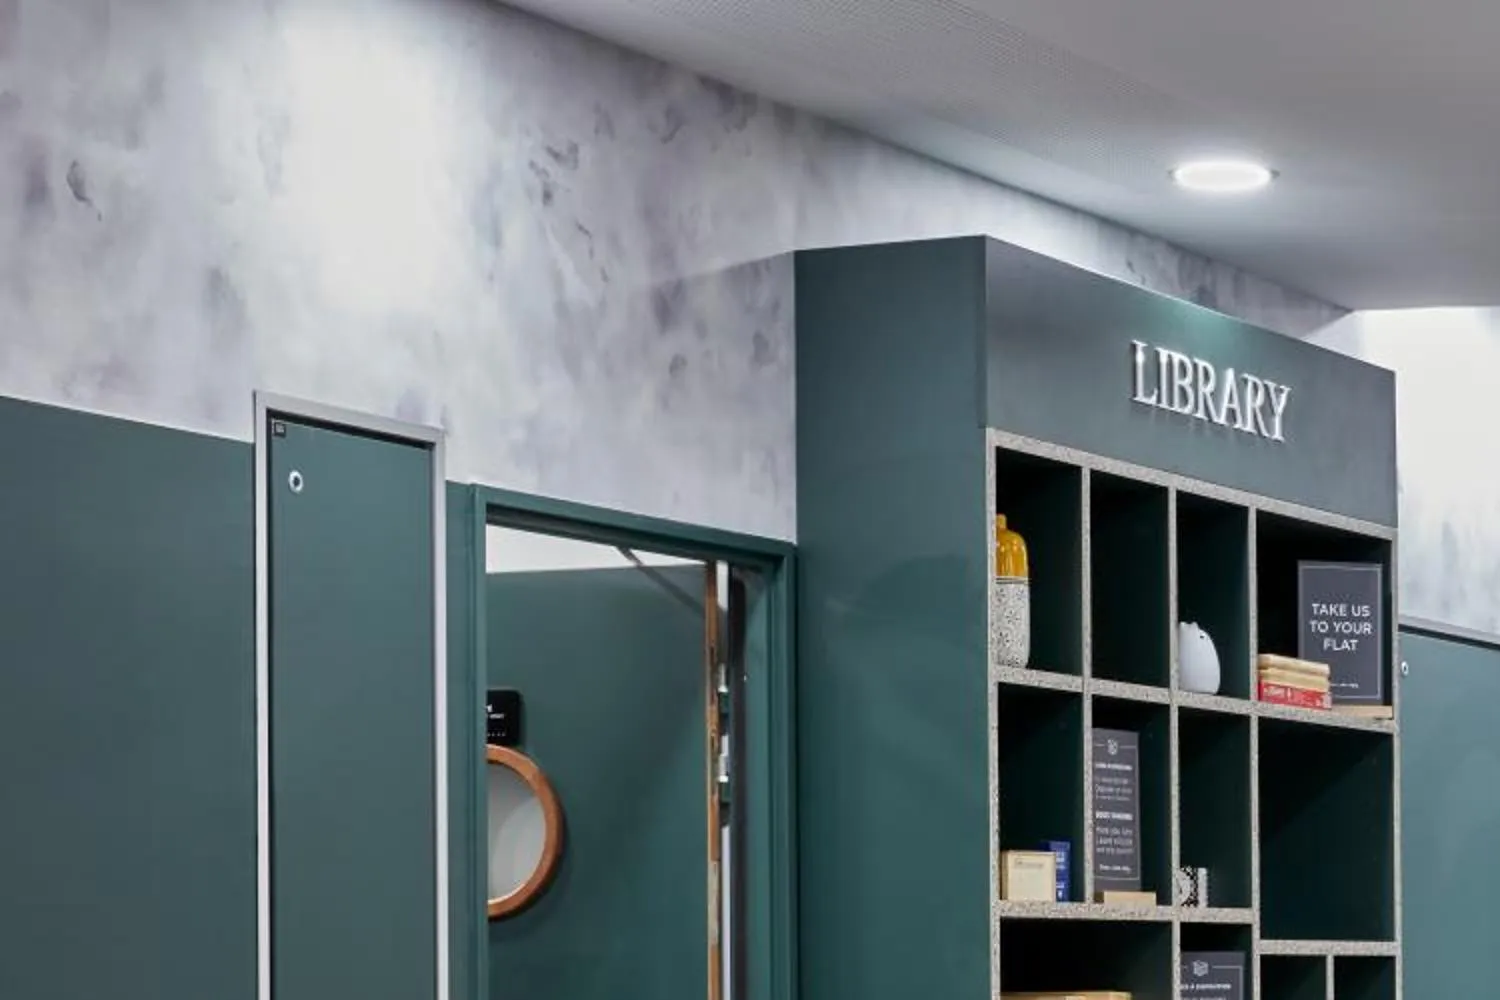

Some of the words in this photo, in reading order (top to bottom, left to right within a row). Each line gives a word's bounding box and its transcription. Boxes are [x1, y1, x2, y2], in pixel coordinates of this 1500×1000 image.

[1131, 339, 1292, 442] LIBRARY
[1311, 603, 1347, 617] TAKE
[1352, 605, 1371, 617] US
[1309, 620, 1329, 633] TO
[1333, 621, 1373, 635] YOUR
[1323, 638, 1359, 651] FLAT
